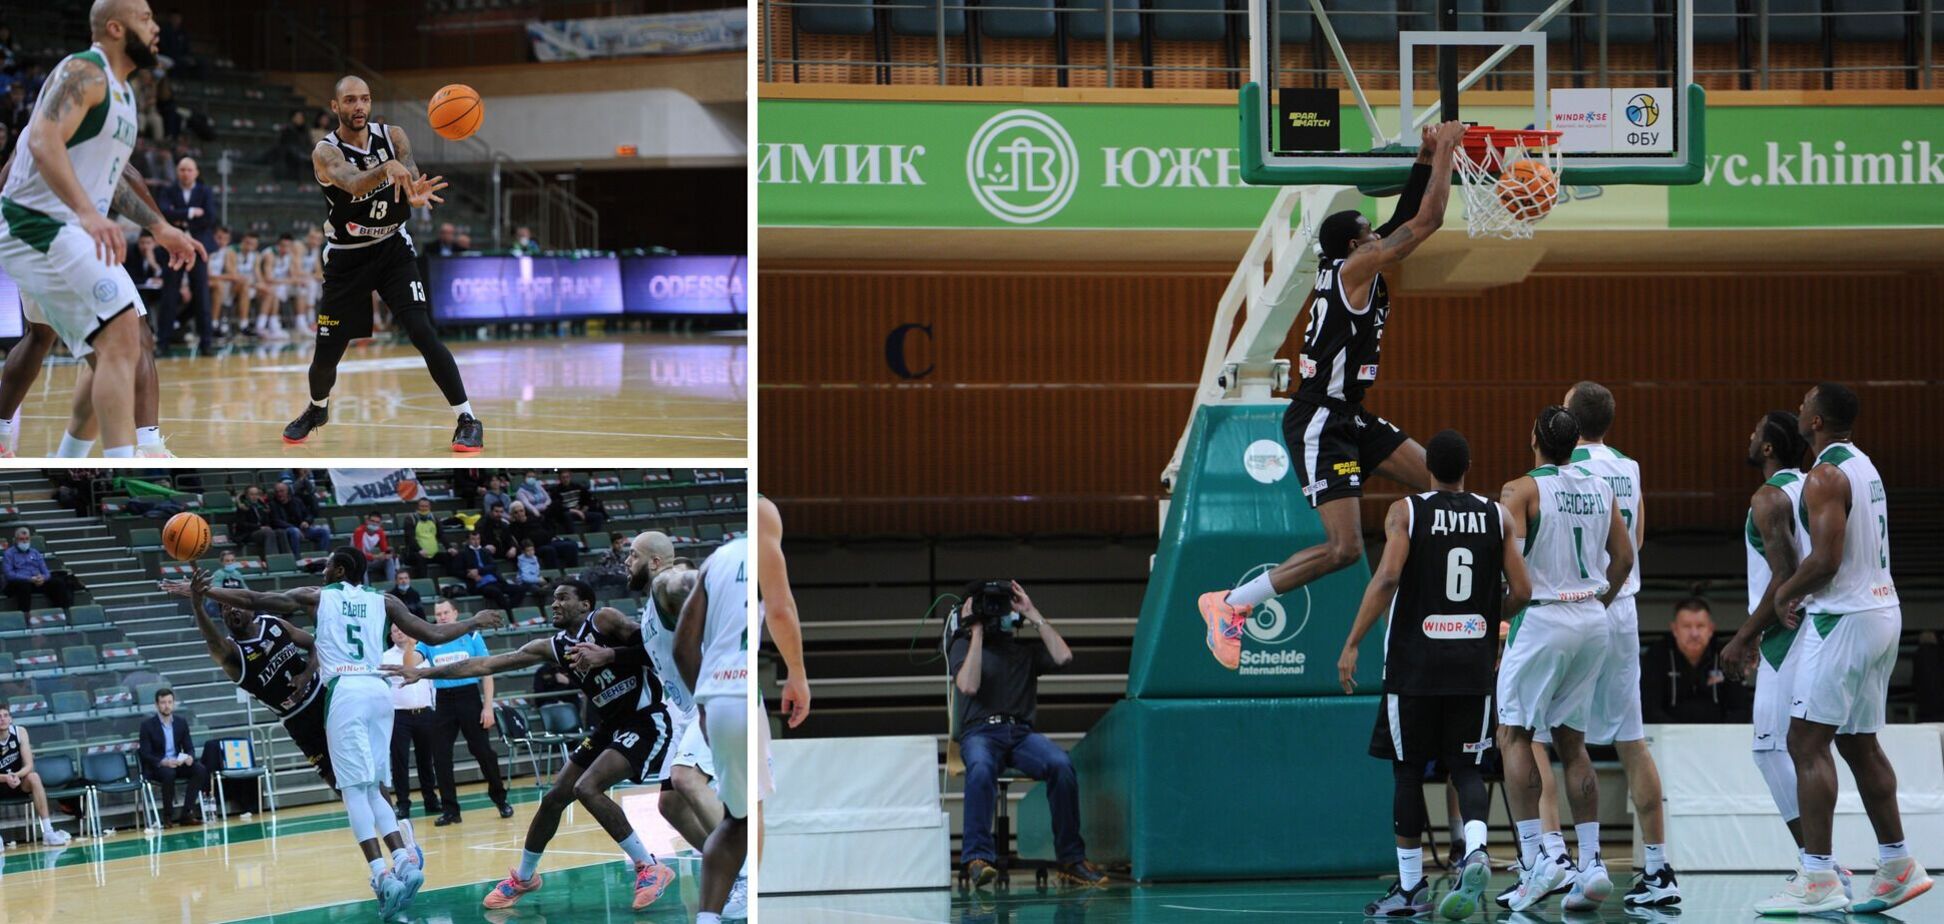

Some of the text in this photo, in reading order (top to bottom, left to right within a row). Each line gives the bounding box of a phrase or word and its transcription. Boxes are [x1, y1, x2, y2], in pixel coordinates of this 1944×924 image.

[1626, 131, 1660, 147] ФБУ
[369, 199, 389, 220] 13
[409, 280, 427, 302] 13
[649, 274, 744, 300] ODESSA
[1431, 508, 1487, 536] ДУГАТ
[1572, 526, 1590, 579] 1
[1445, 546, 1474, 602] 6
[346, 623, 365, 660] 5
[1240, 649, 1306, 665] Schelde
[1239, 664, 1305, 675] International
